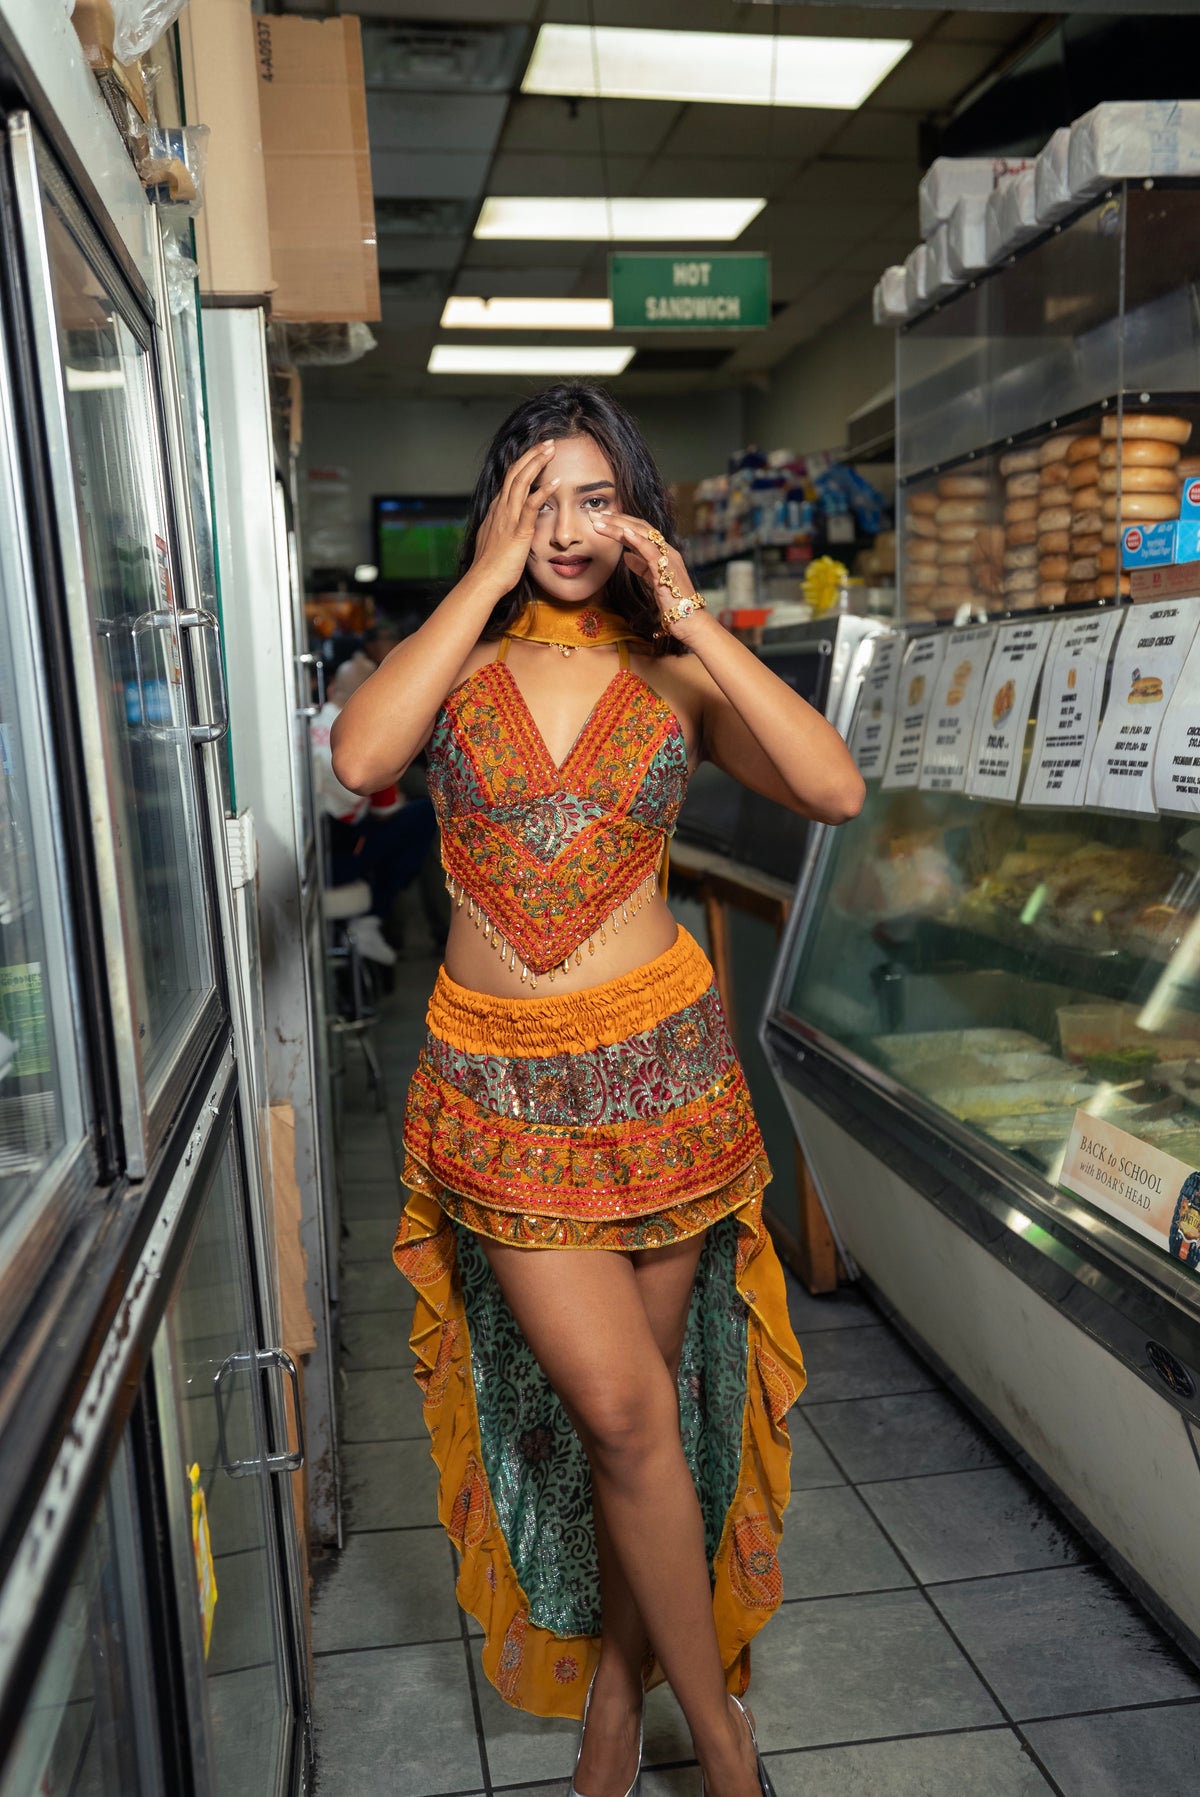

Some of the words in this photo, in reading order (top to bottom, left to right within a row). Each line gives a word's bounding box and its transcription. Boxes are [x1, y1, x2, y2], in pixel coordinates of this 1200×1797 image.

[672, 262, 711, 286] HOT
[646, 296, 740, 320] SANDWICH
[1080, 1136, 1107, 1162] BACK
[1108, 1153, 1117, 1168] to
[1119, 1157, 1162, 1194] SCHOOL
[1080, 1161, 1094, 1177] with
[1096, 1168, 1124, 1194] BOAR'S
[1125, 1186, 1151, 1211] HEAD.
